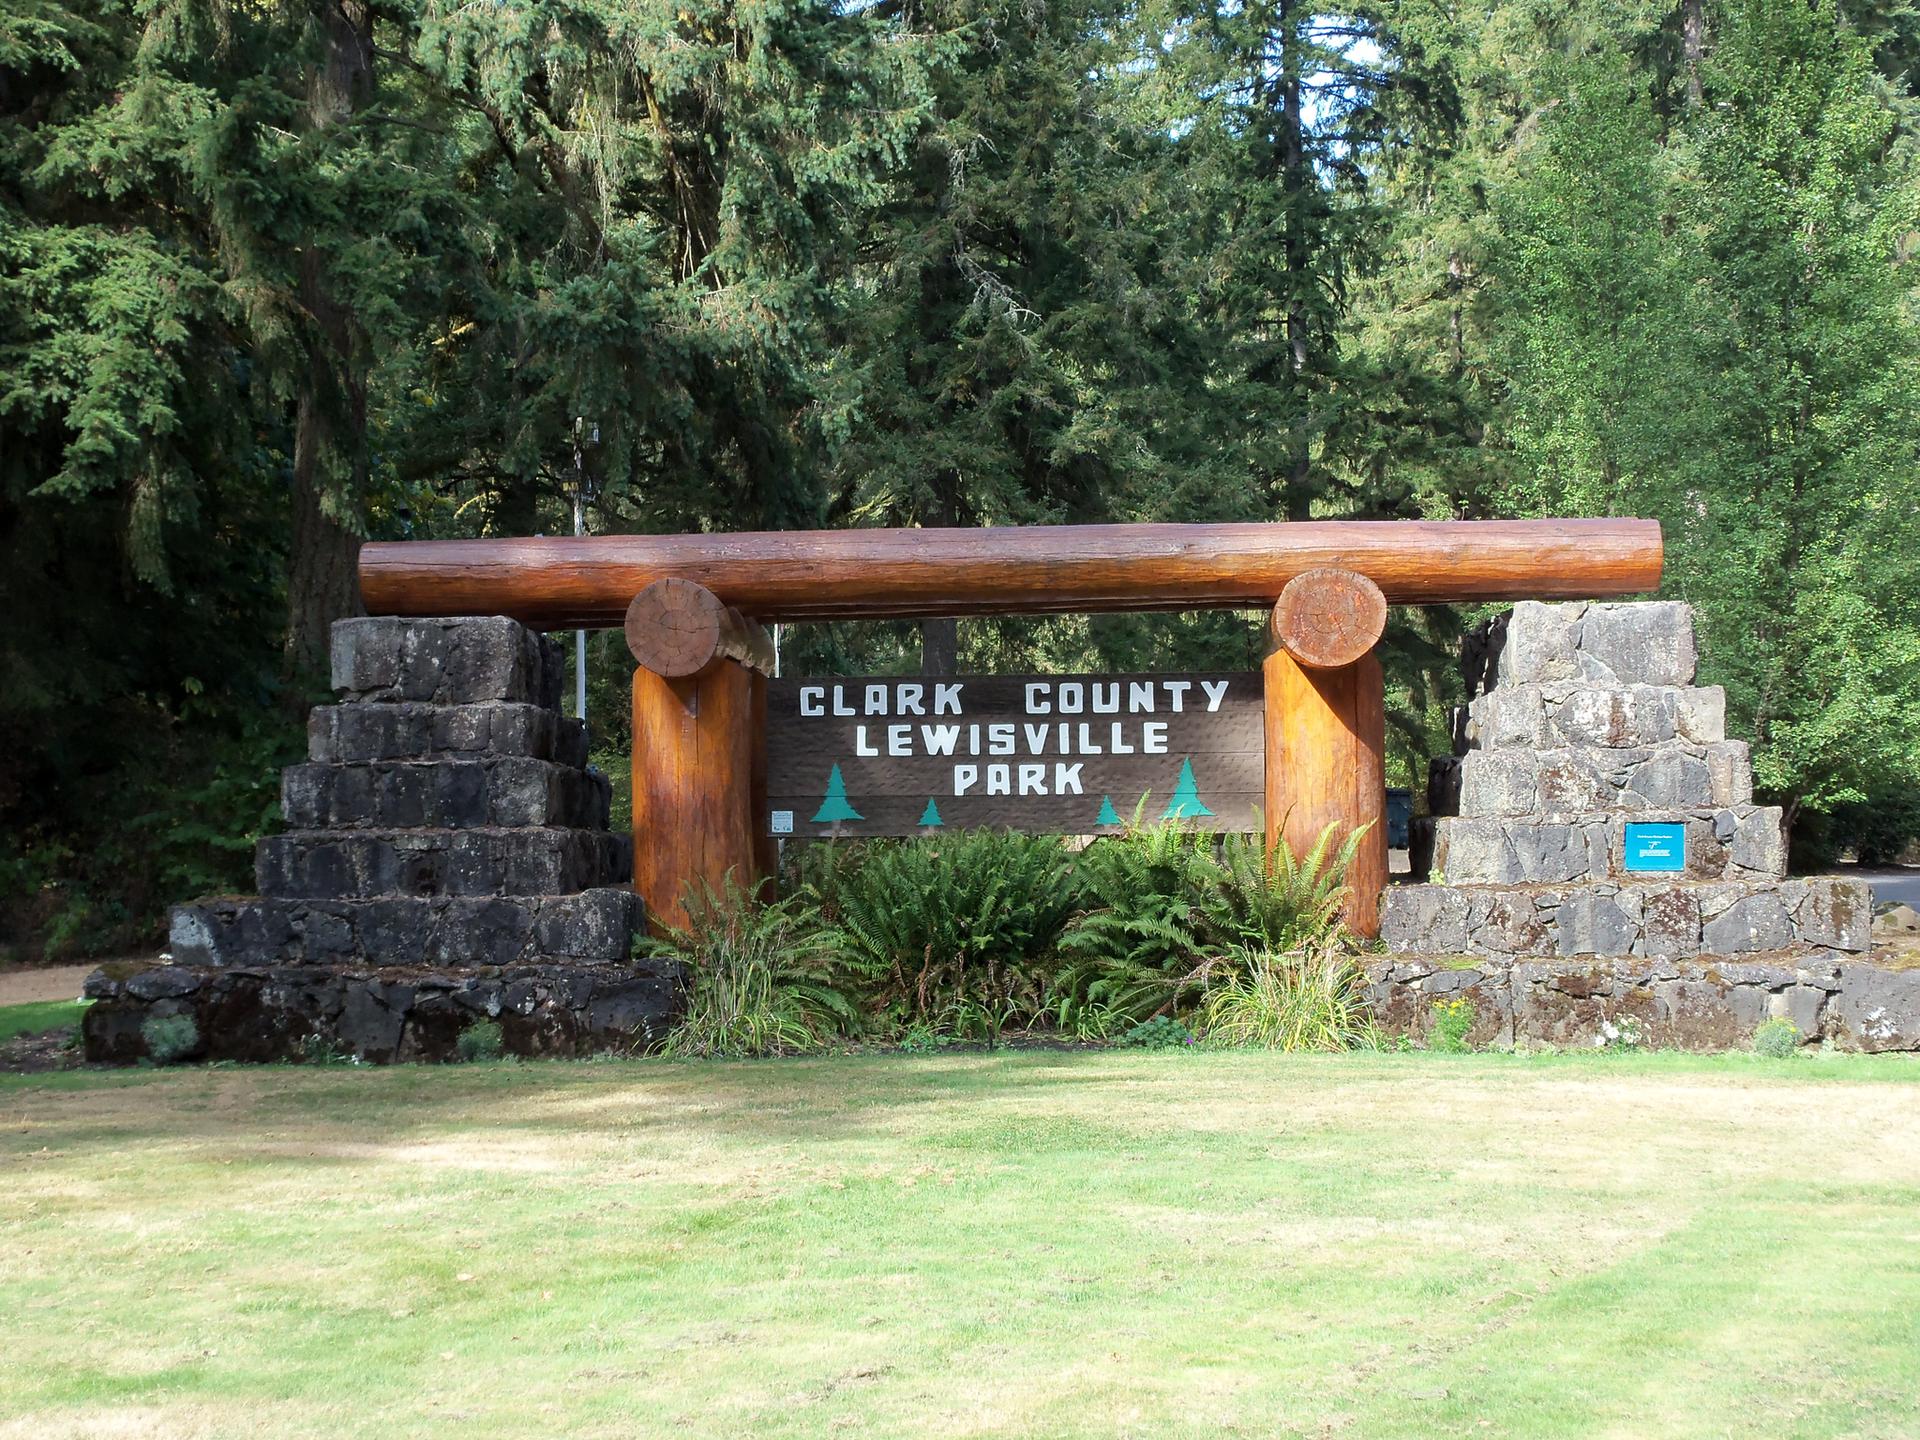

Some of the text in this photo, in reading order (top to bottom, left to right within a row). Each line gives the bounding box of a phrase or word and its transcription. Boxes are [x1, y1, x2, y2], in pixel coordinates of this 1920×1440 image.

[799, 680, 1230, 717] CLARK COUNTY
[855, 721, 1169, 757] LEWISVILLE
[953, 762, 1085, 796] PARK
